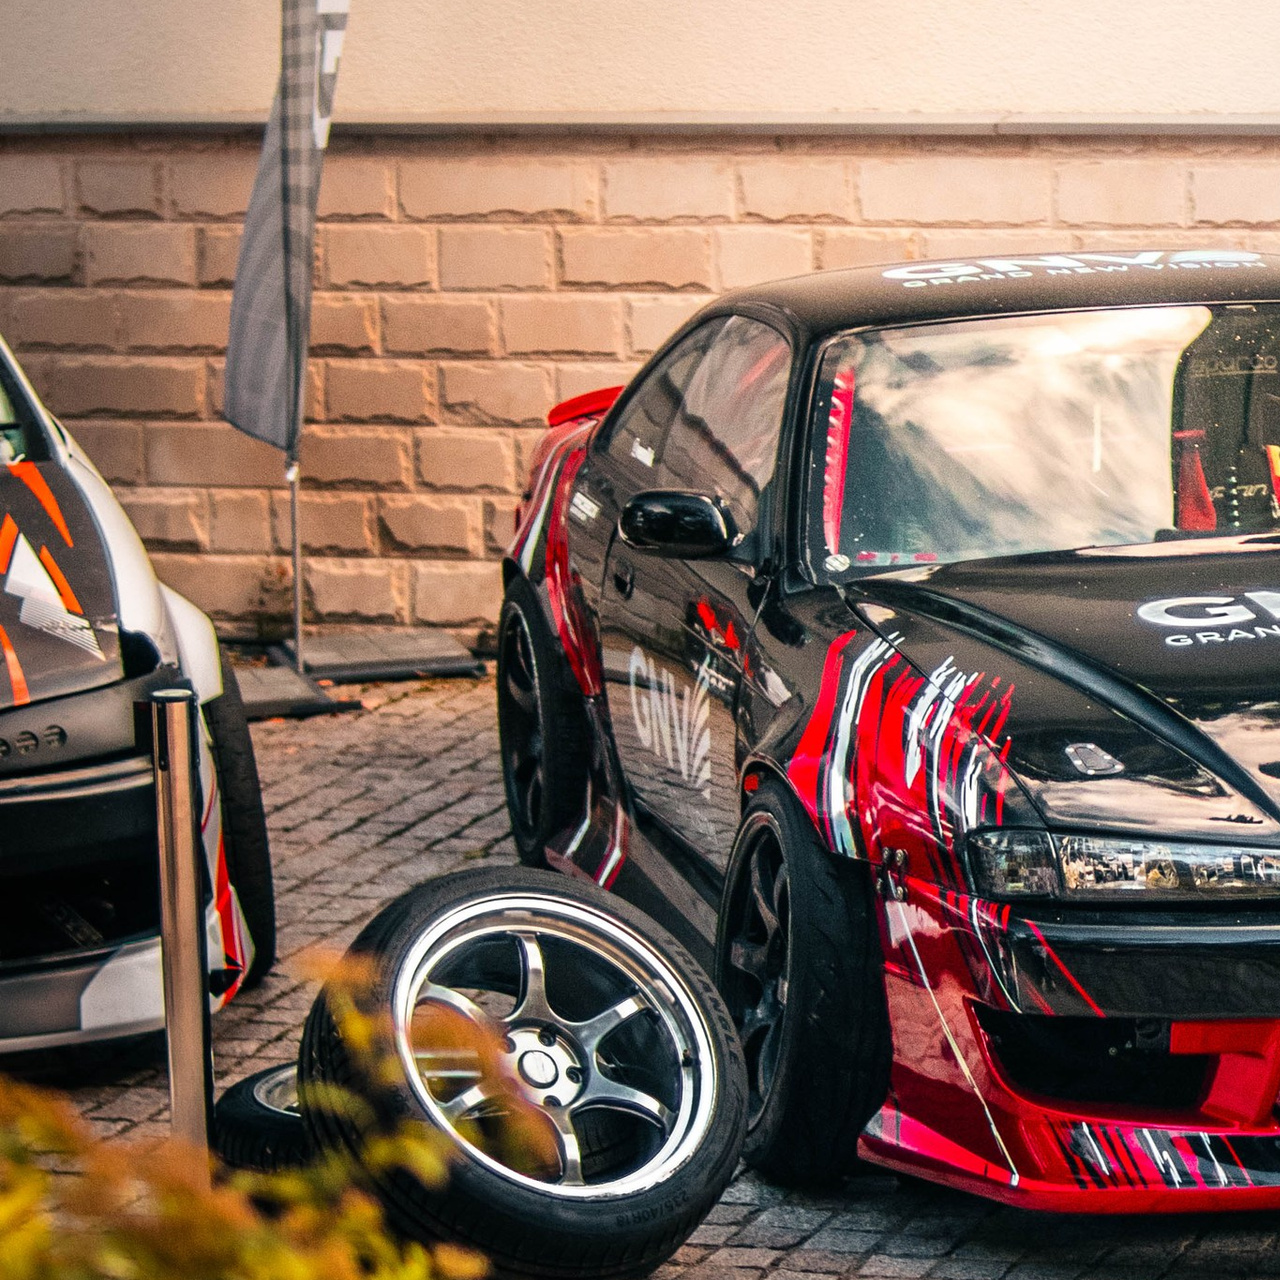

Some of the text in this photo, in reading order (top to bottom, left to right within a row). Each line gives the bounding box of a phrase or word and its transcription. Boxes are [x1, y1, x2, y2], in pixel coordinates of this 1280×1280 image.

[881, 251, 1165, 281] GNV
[902, 261, 1267, 288] GRAND NEW VISION
[629, 644, 692, 782] GNV
